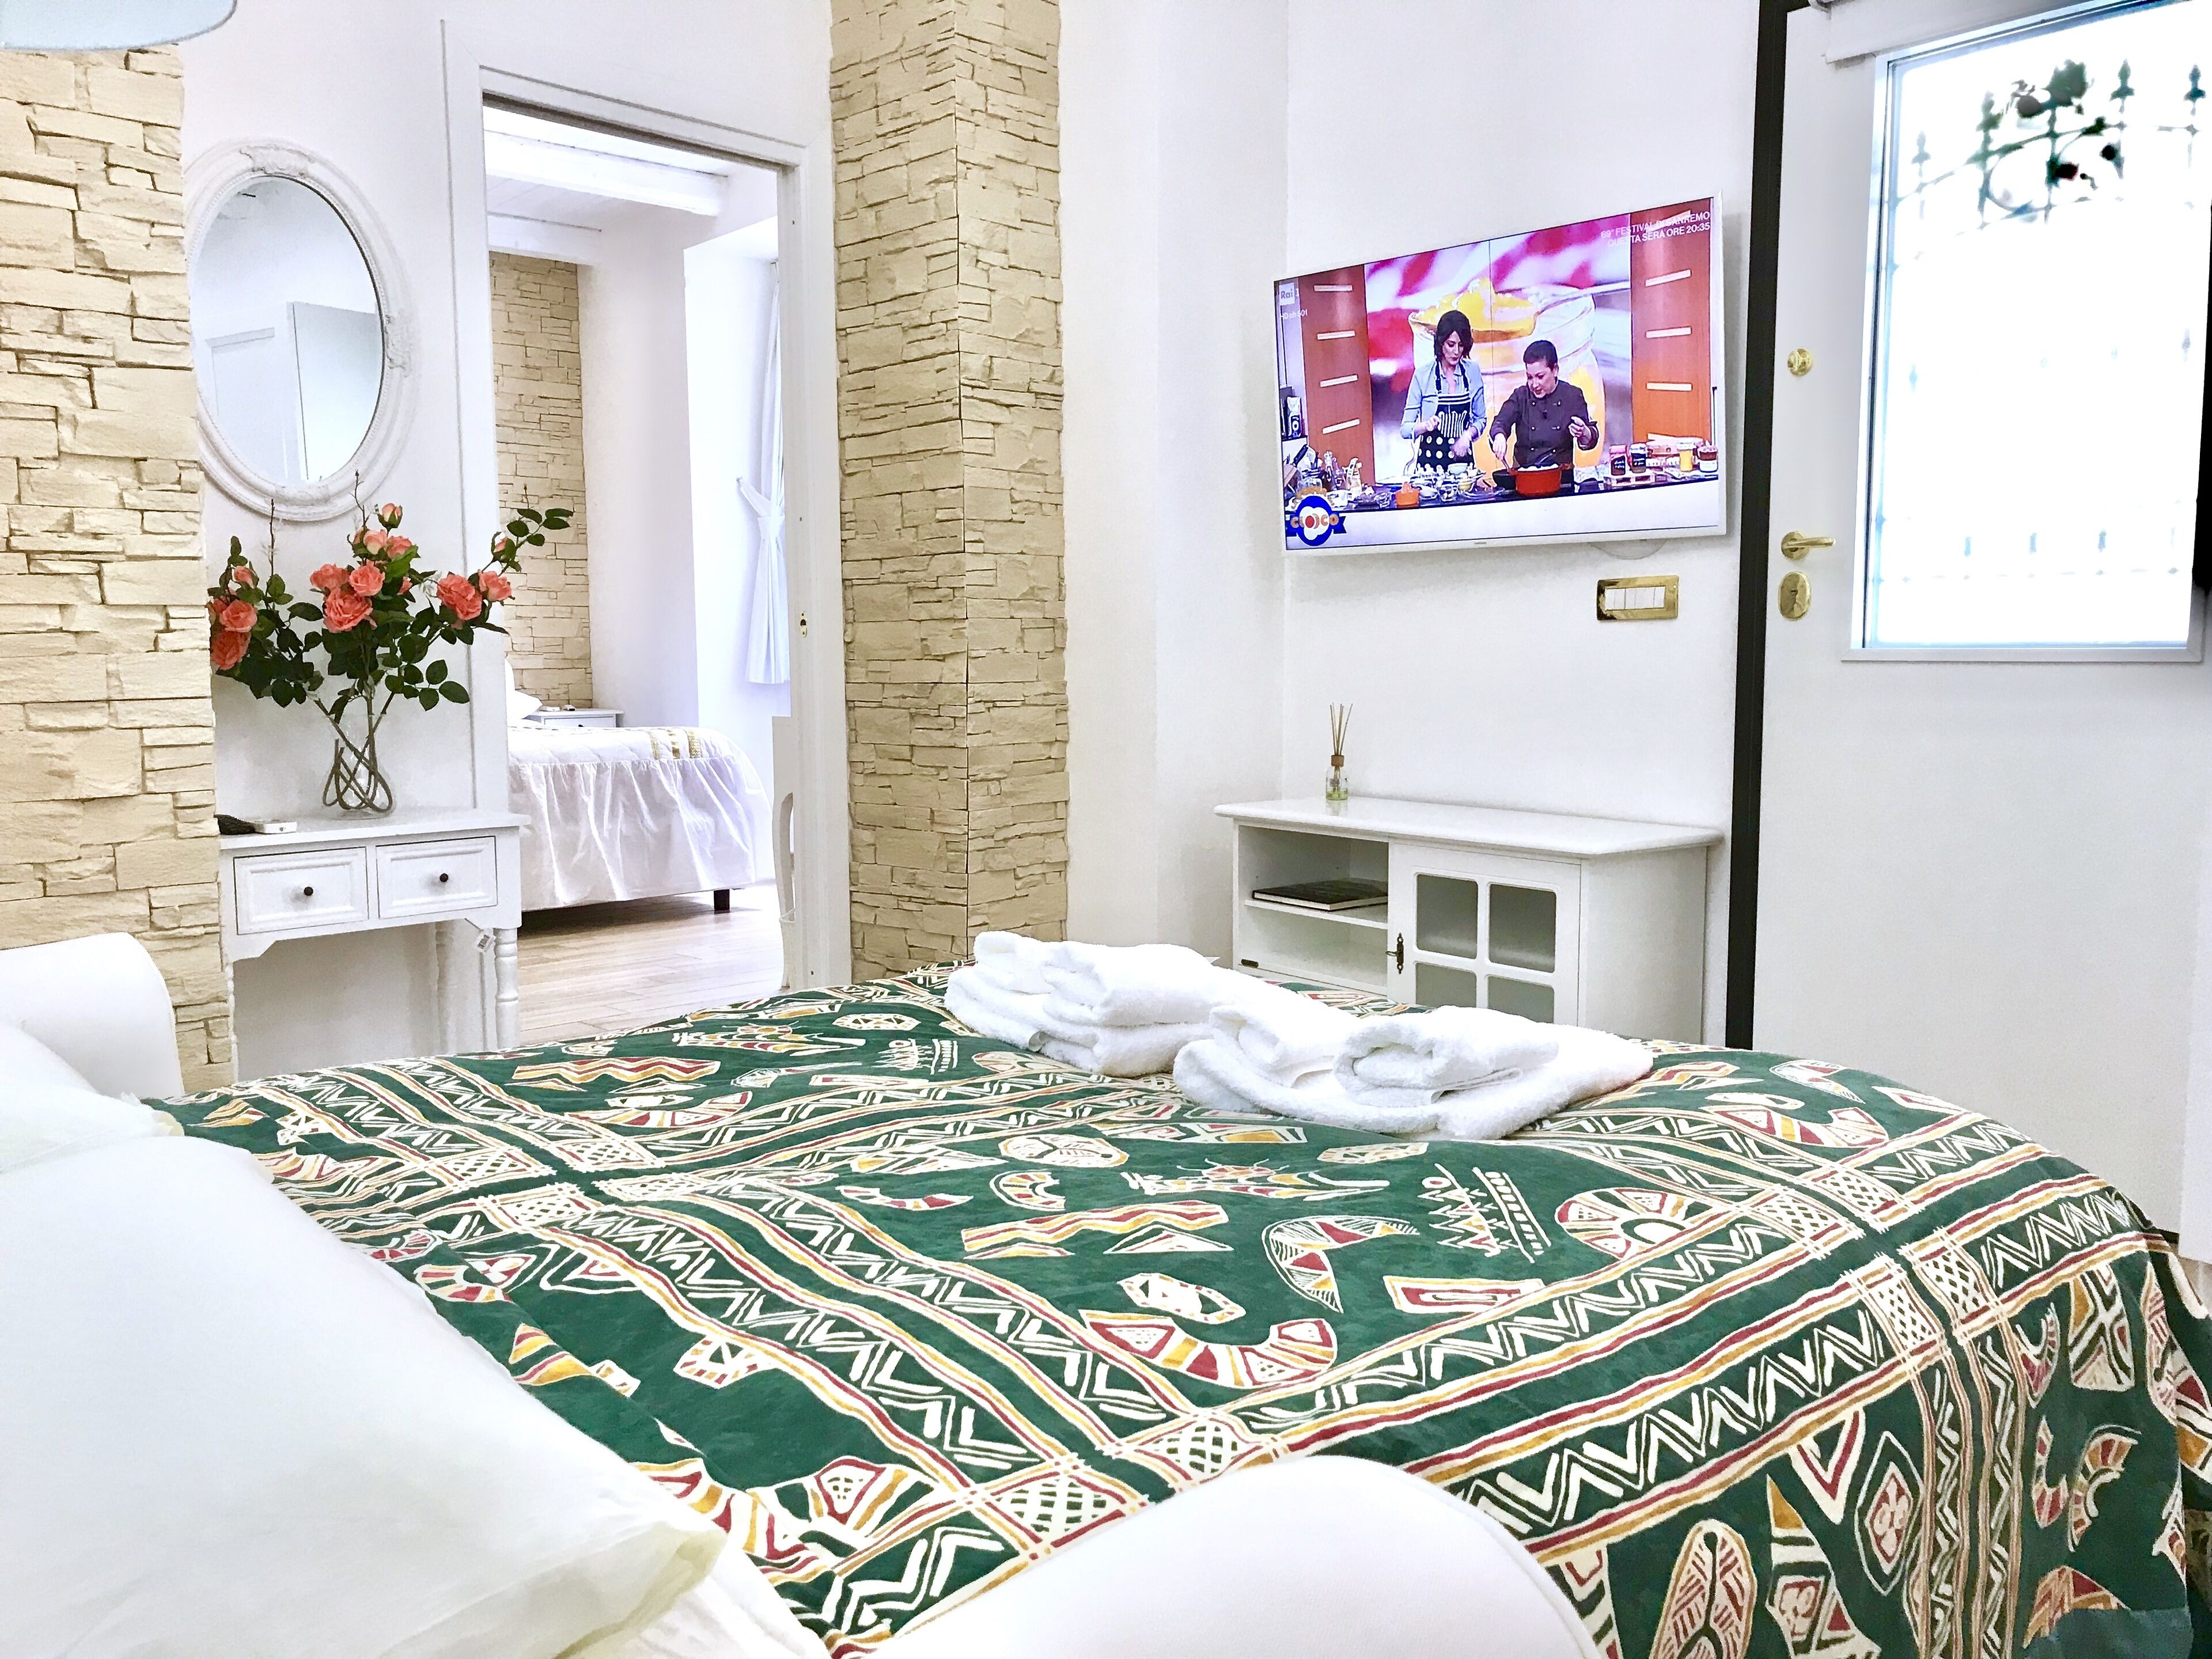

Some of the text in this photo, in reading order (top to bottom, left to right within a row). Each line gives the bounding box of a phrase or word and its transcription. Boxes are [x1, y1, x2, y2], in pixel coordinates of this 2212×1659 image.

[1608, 222, 1711, 247] QUESTA SERA ORE 20:35
[1281, 289, 1293, 299] Rai
[1296, 309, 1308, 317] 501
